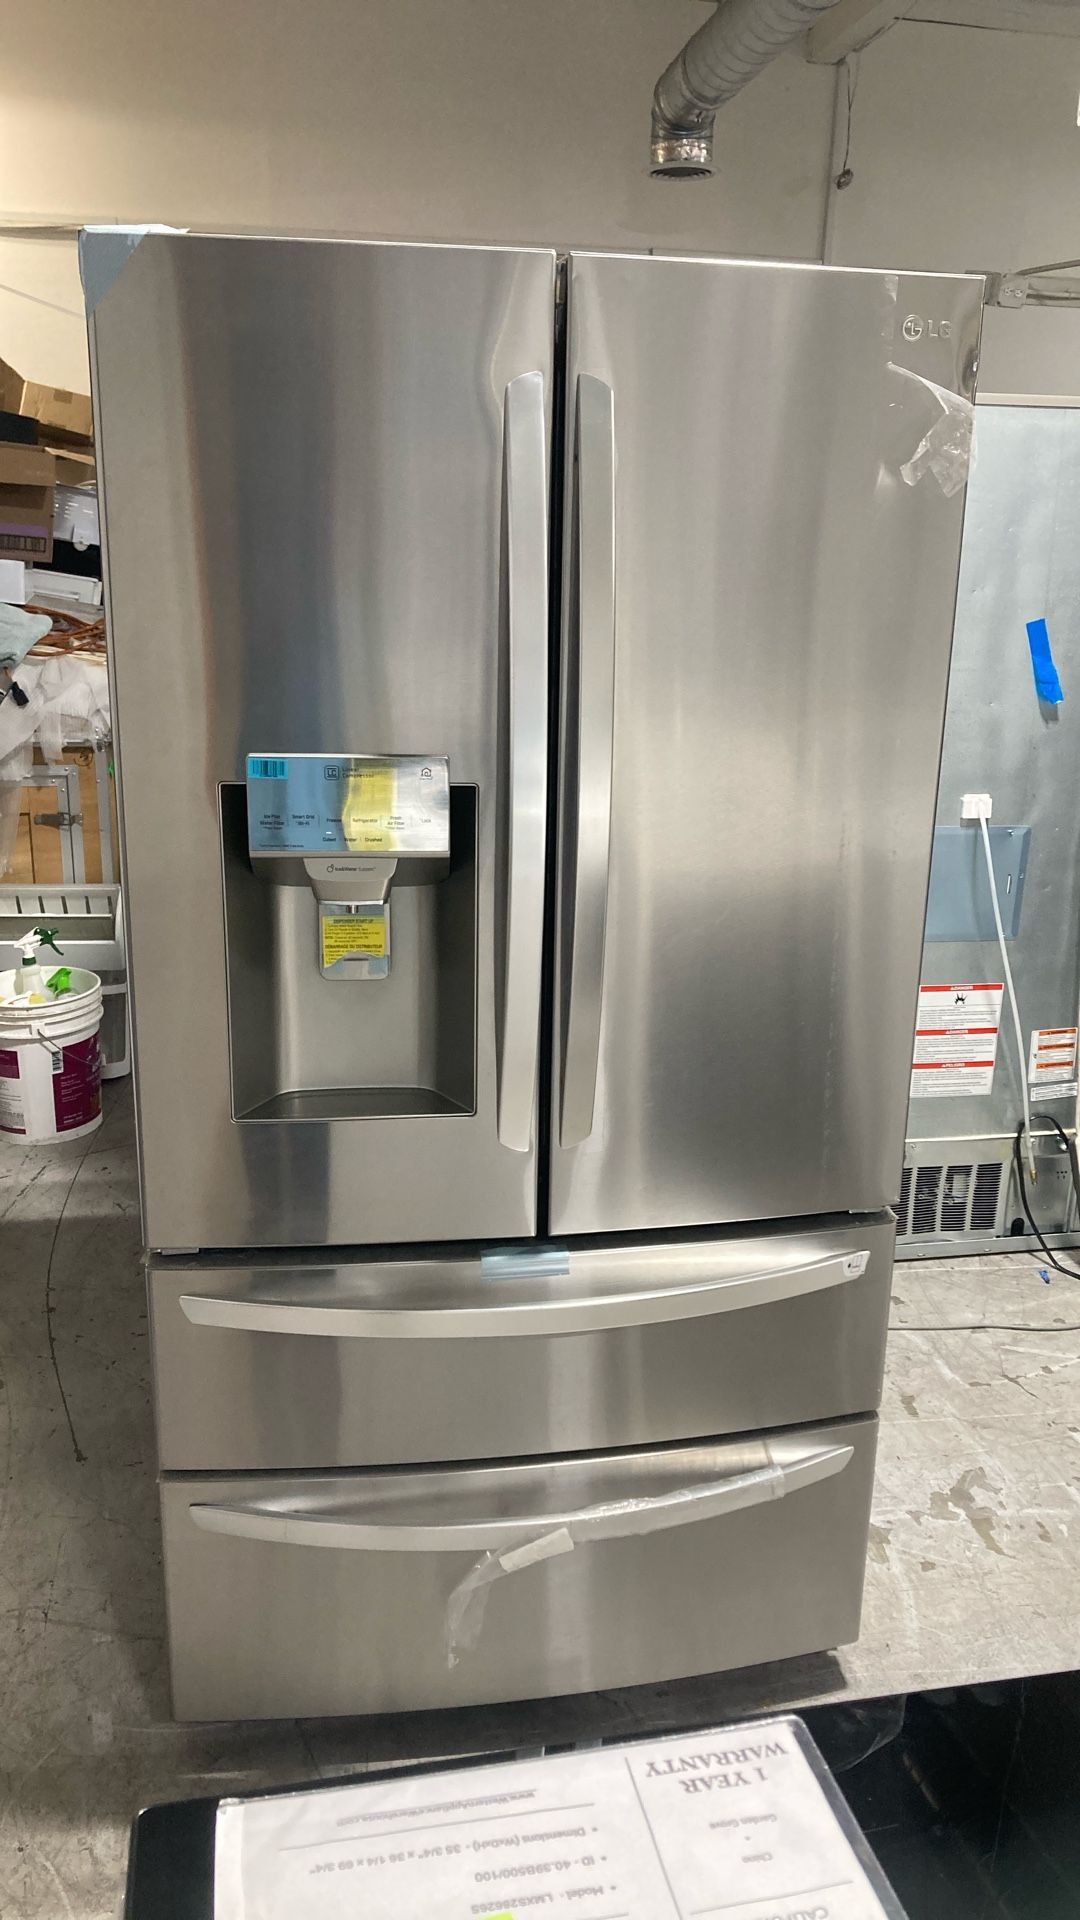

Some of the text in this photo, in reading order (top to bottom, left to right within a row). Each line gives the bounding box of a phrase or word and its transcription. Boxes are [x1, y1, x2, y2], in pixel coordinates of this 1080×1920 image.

[927, 319, 952, 338] LG
[645, 1742, 788, 1778] WARRANTY
[678, 1767, 768, 1795] 1 YEAR
[708, 1814, 778, 1830] Garden Grove
[521, 1827, 586, 1845] Dimensions
[366, 1855, 386, 1869] 1/4
[581, 1855, 595, 1867] ID
[566, 1886, 604, 1901] Model
